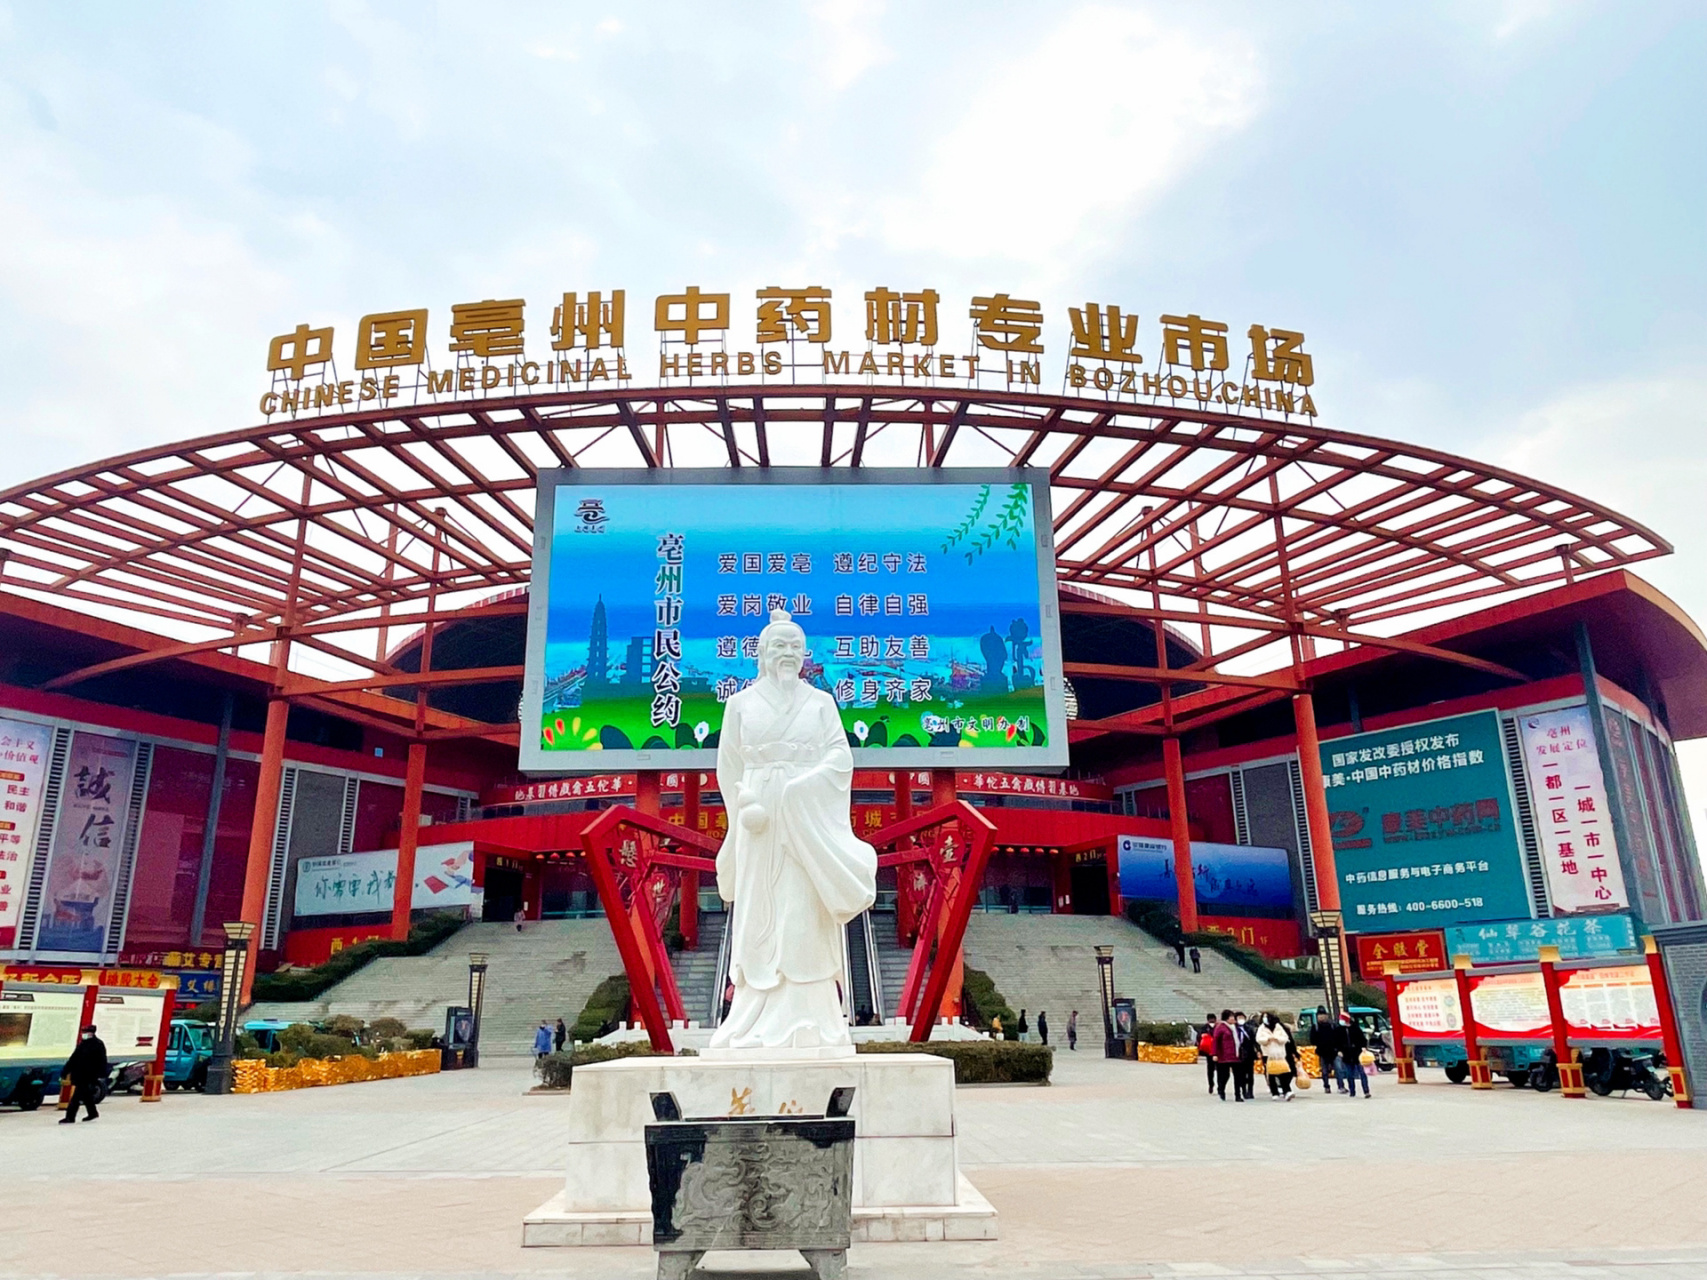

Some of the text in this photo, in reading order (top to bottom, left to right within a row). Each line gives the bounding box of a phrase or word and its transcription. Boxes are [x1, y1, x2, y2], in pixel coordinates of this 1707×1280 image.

[266, 286, 1316, 387] 中国亳州中药材专业市场
[259, 374, 401, 416] CHINESE
[427, 356, 632, 394] MEDICINAL
[660, 351, 783, 378] HERBS
[823, 350, 980, 379] MARKET
[1007, 359, 1041, 385] IN
[717, 551, 928, 575] 爱国爱亳 遵纪守法
[716, 593, 931, 617] 爱岗敬业 自律自强
[651, 533, 685, 728] 亳州市民公约
[834, 635, 931, 659] 互助友善
[835, 677, 933, 702] 修身齐家
[1546, 725, 1572, 739] 亳州
[1332, 733, 1460, 768] 国家发改委授权发布
[1536, 738, 1588, 756] 发展定位
[1405, 897, 1485, 913] 400-6600-518
